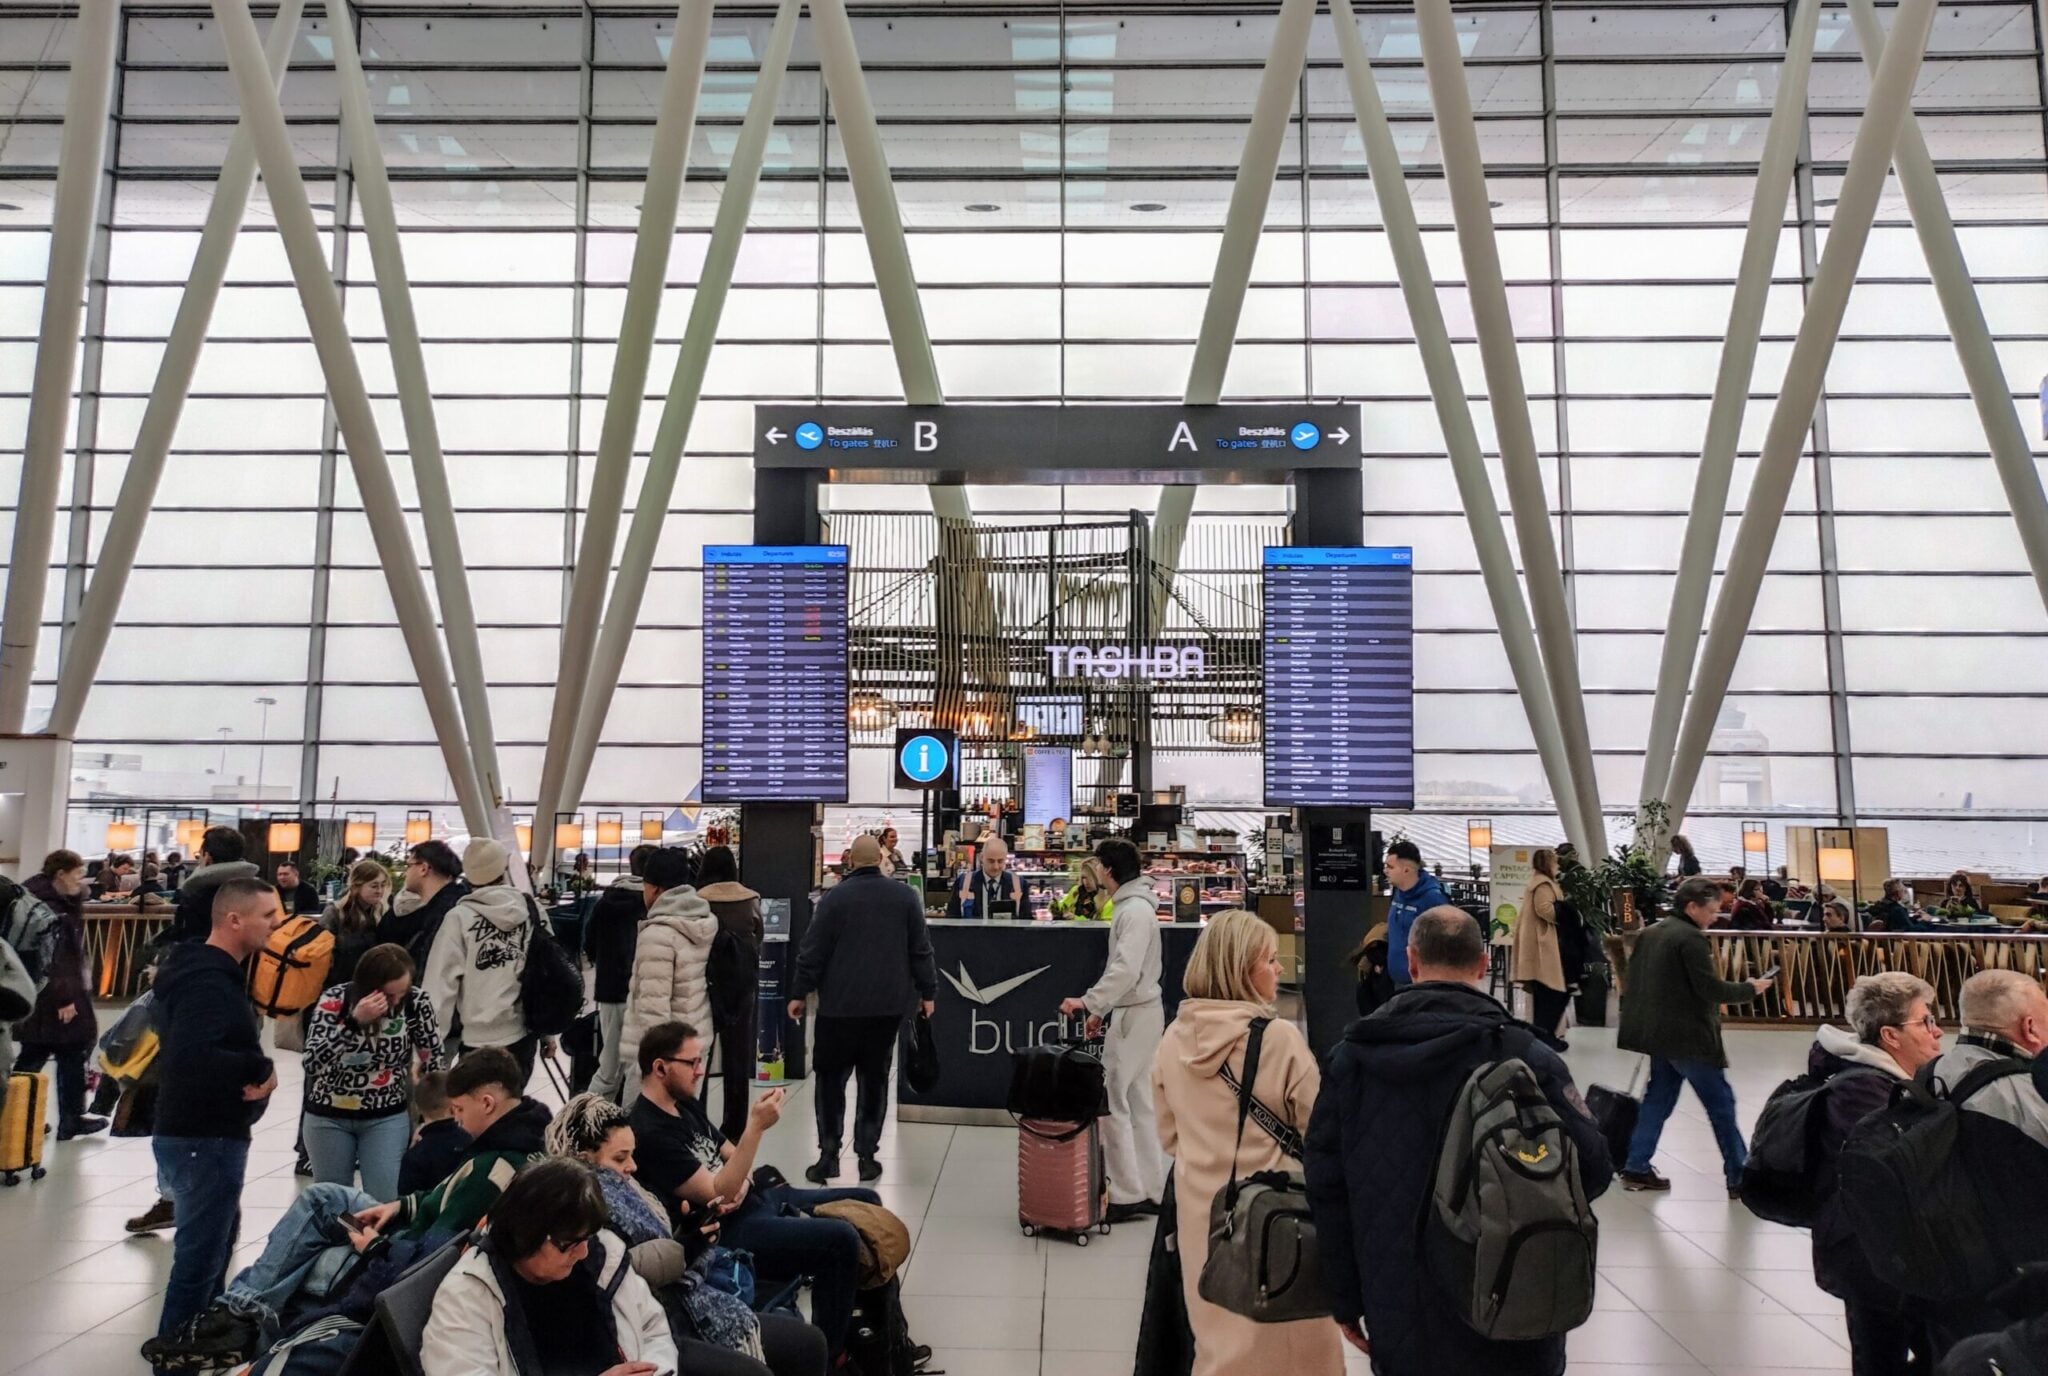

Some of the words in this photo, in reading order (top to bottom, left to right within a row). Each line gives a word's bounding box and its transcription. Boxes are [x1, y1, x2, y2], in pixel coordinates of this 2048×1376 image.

[828, 438, 840, 448] To
[842, 439, 869, 449] gates
[914, 421, 938, 452] B
[1168, 421, 1198, 452] A
[1216, 438, 1228, 448] To
[1231, 440, 1258, 449] gates
[1044, 645, 1205, 678] TASHBA
